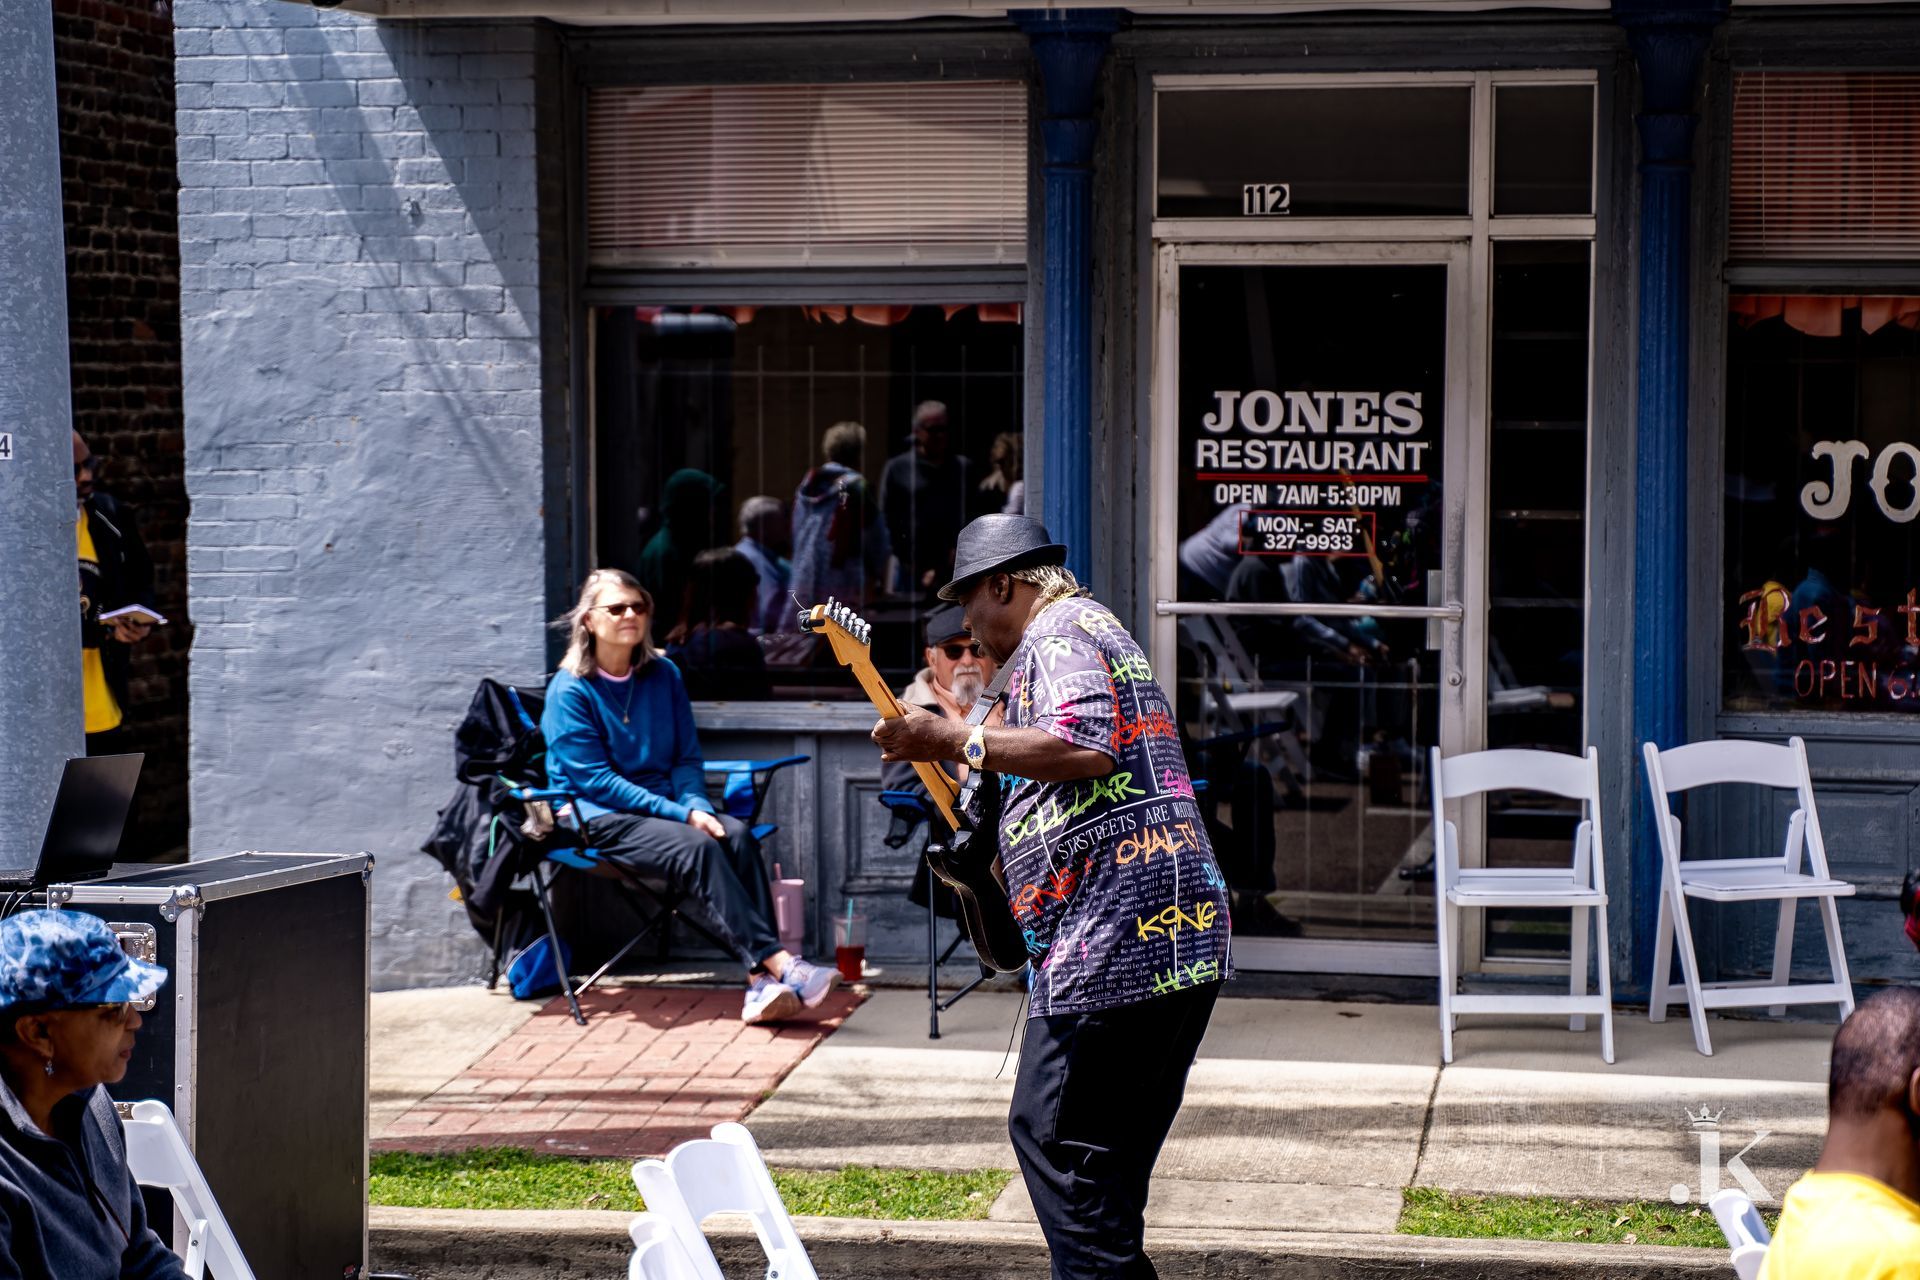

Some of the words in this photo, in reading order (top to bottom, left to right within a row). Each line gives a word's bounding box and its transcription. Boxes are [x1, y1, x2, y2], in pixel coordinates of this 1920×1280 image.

[1245, 185, 1288, 213] 112
[1203, 390, 1424, 434] JONES
[1196, 439, 1429, 471] RESTAURANT
[1215, 483, 1267, 504] OPEN
[1276, 485, 1401, 506] 7AM-5:30PM
[1800, 440, 1920, 523] JO
[1264, 534, 1353, 550] 327-9933
[1323, 518, 1361, 534] SAT.
[1794, 659, 1876, 699] OPEN
[1004, 771, 1147, 847] DOLLAR
[1145, 804, 1171, 826] ARE
[1137, 900, 1218, 942] KING
